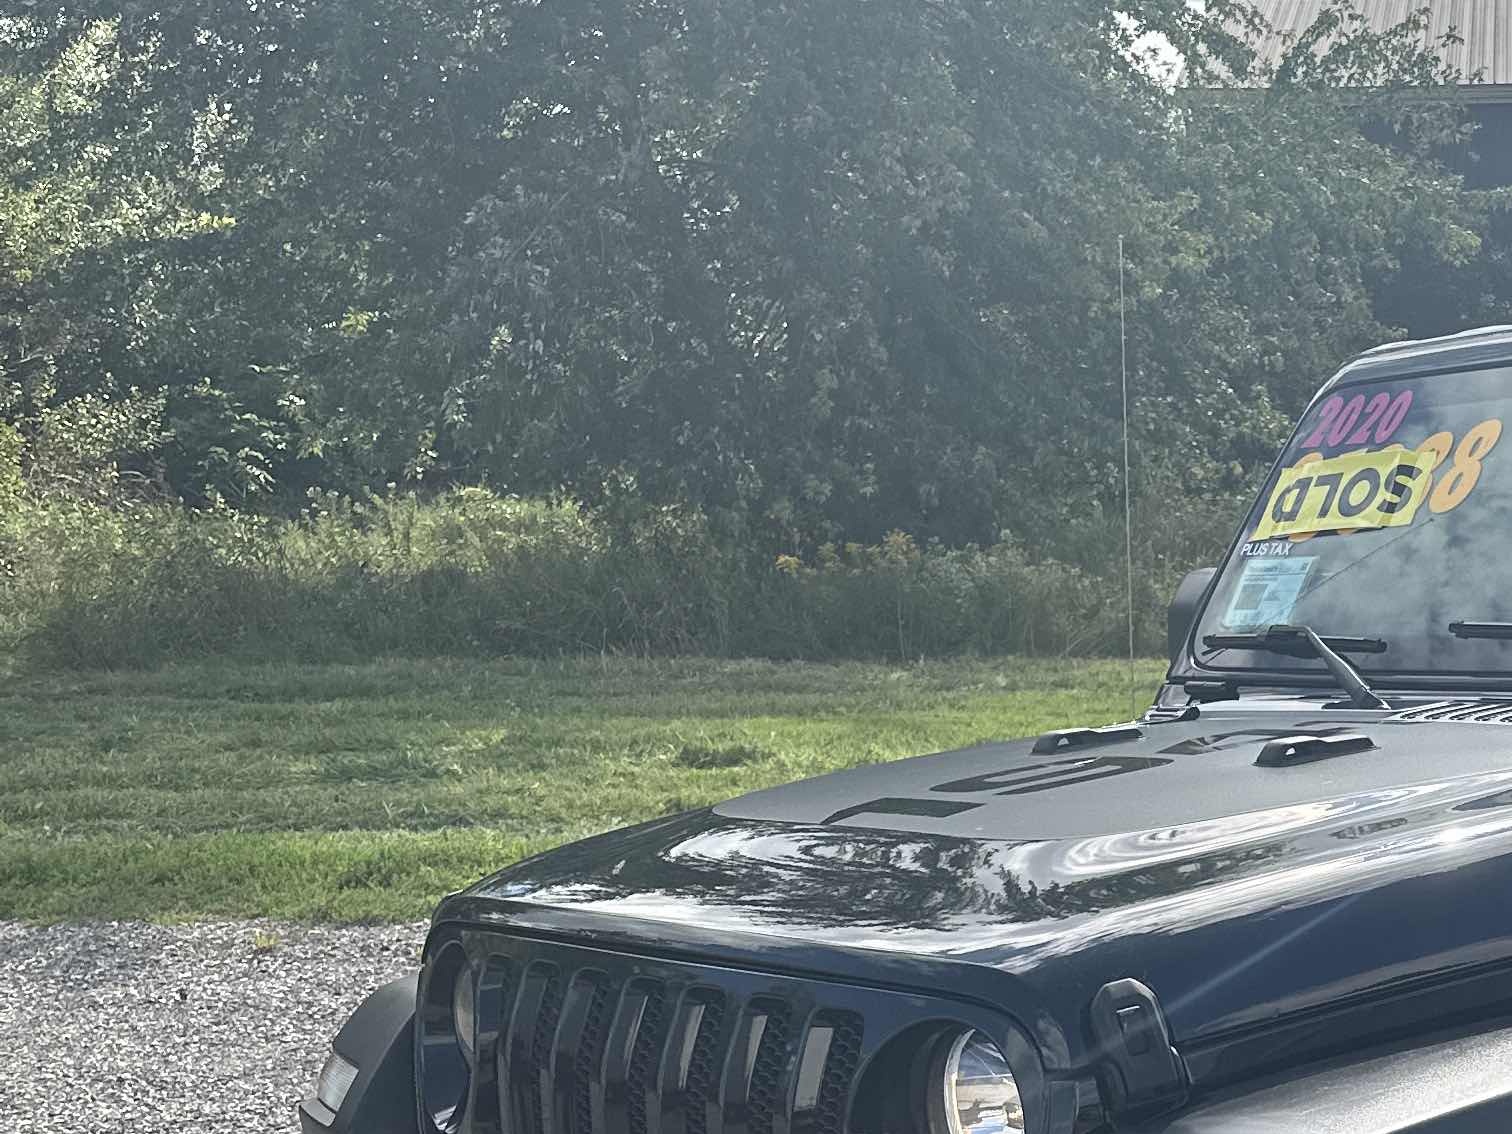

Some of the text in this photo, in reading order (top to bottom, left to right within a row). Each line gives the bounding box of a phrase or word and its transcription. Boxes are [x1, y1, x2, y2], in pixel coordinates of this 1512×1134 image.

[1301, 390, 1414, 448] 2020
[1271, 464, 1423, 523] SOLD
[1240, 543, 1293, 556] PLUS TAX
